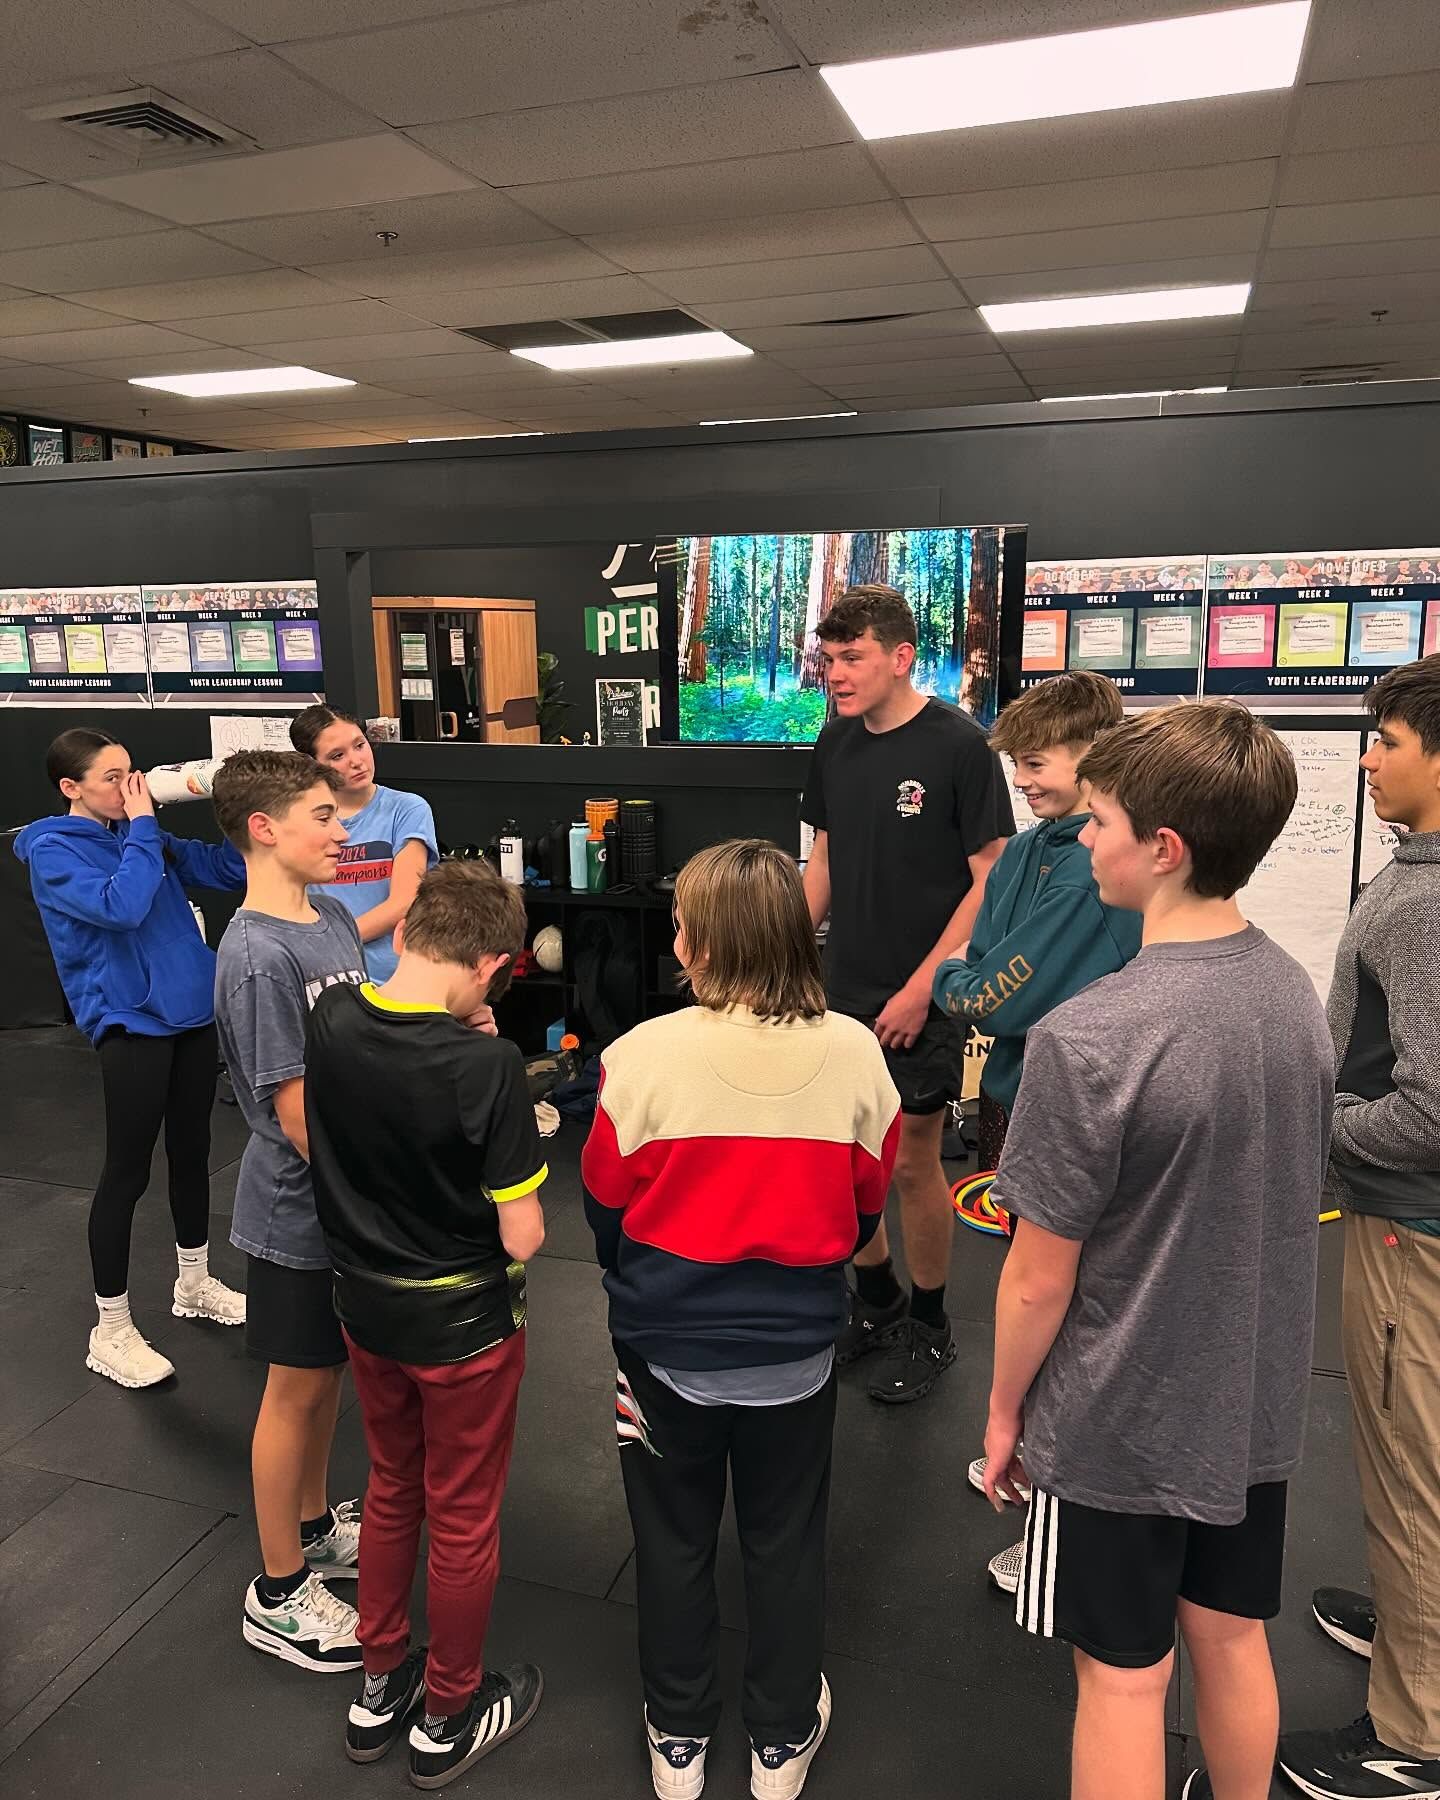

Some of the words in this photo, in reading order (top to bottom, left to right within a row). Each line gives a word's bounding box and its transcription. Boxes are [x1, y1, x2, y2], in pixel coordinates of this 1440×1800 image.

[33, 439, 62, 453] WET
[1318, 560, 1386, 575] NOVEMBER
[204, 590, 250, 601] SEPTEMBER
[1153, 594, 1176, 602] WEEK
[1178, 593, 1185, 601] 4
[1228, 592, 1251, 600] WEEK
[1254, 591, 1258, 600] 1
[1298, 590, 1321, 598] WEEK
[1324, 589, 1330, 598] 2
[1370, 588, 1395, 597] WEEK
[1086, 595, 1109, 604] WEEK
[597, 606, 660, 656] PER
[1267, 676, 1300, 686] YOUTH
[1304, 675, 1370, 686] LEADERSHIP
[339, 846, 366, 863] 2024
[334, 865, 388, 886] ampions
[763, 1755, 778, 1763] AIR
